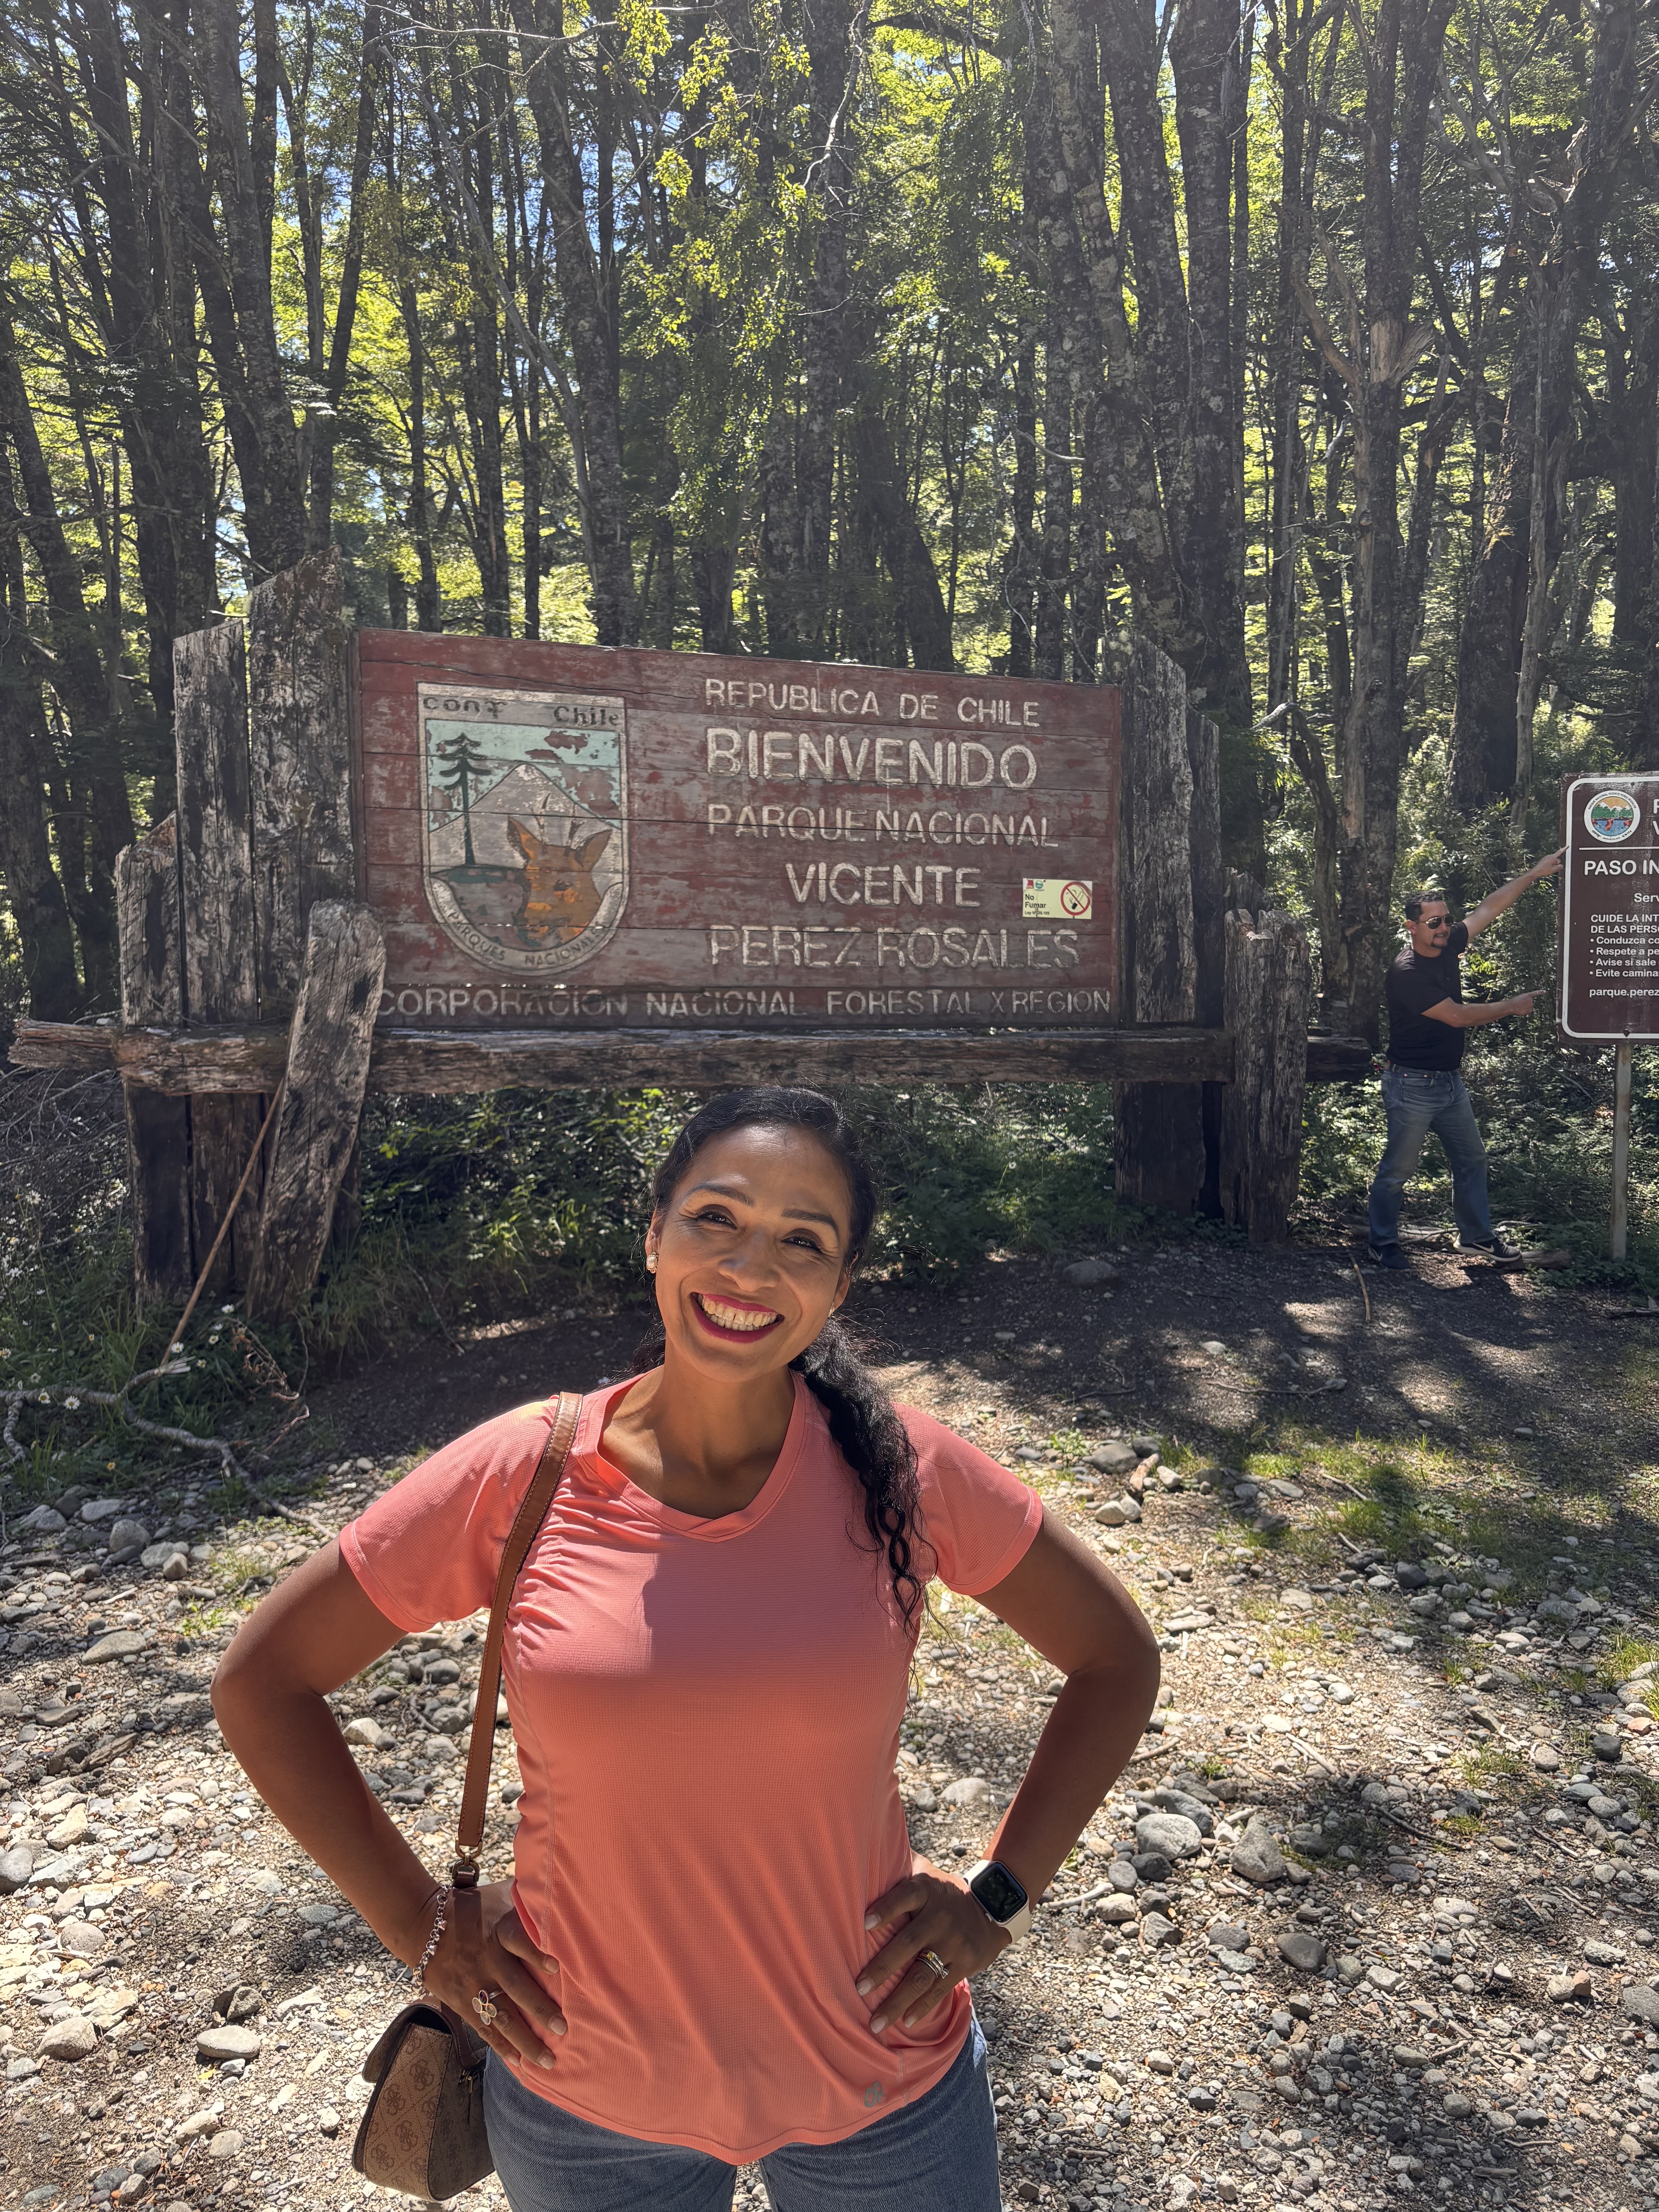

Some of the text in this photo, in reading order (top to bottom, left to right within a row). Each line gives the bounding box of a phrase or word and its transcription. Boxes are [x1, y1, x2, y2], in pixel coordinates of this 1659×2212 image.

[706, 679, 1039, 727] REPUBLICA DE CHILE
[554, 706, 619, 726] Chile
[707, 727, 1037, 788] BIENVENIDO
[708, 804, 1058, 847] PARQUE NACIONAL
[1584, 860, 1637, 875] PASO
[785, 862, 981, 907] VICENTE
[1626, 914, 1639, 922] LA
[1642, 914, 1659, 922] INT
[1591, 925, 1659, 933] DE LAS PERS
[710, 925, 1080, 968] PEREZ ROSALES
[1596, 936, 1646, 944] Conduzca
[1596, 947, 1636, 957] Respete
[1635, 958, 1656, 966] sale
[1595, 969, 1659, 977] Evite camina
[380, 988, 1110, 1017] CORPORACION NACIONAL FORESTAL X REGION
